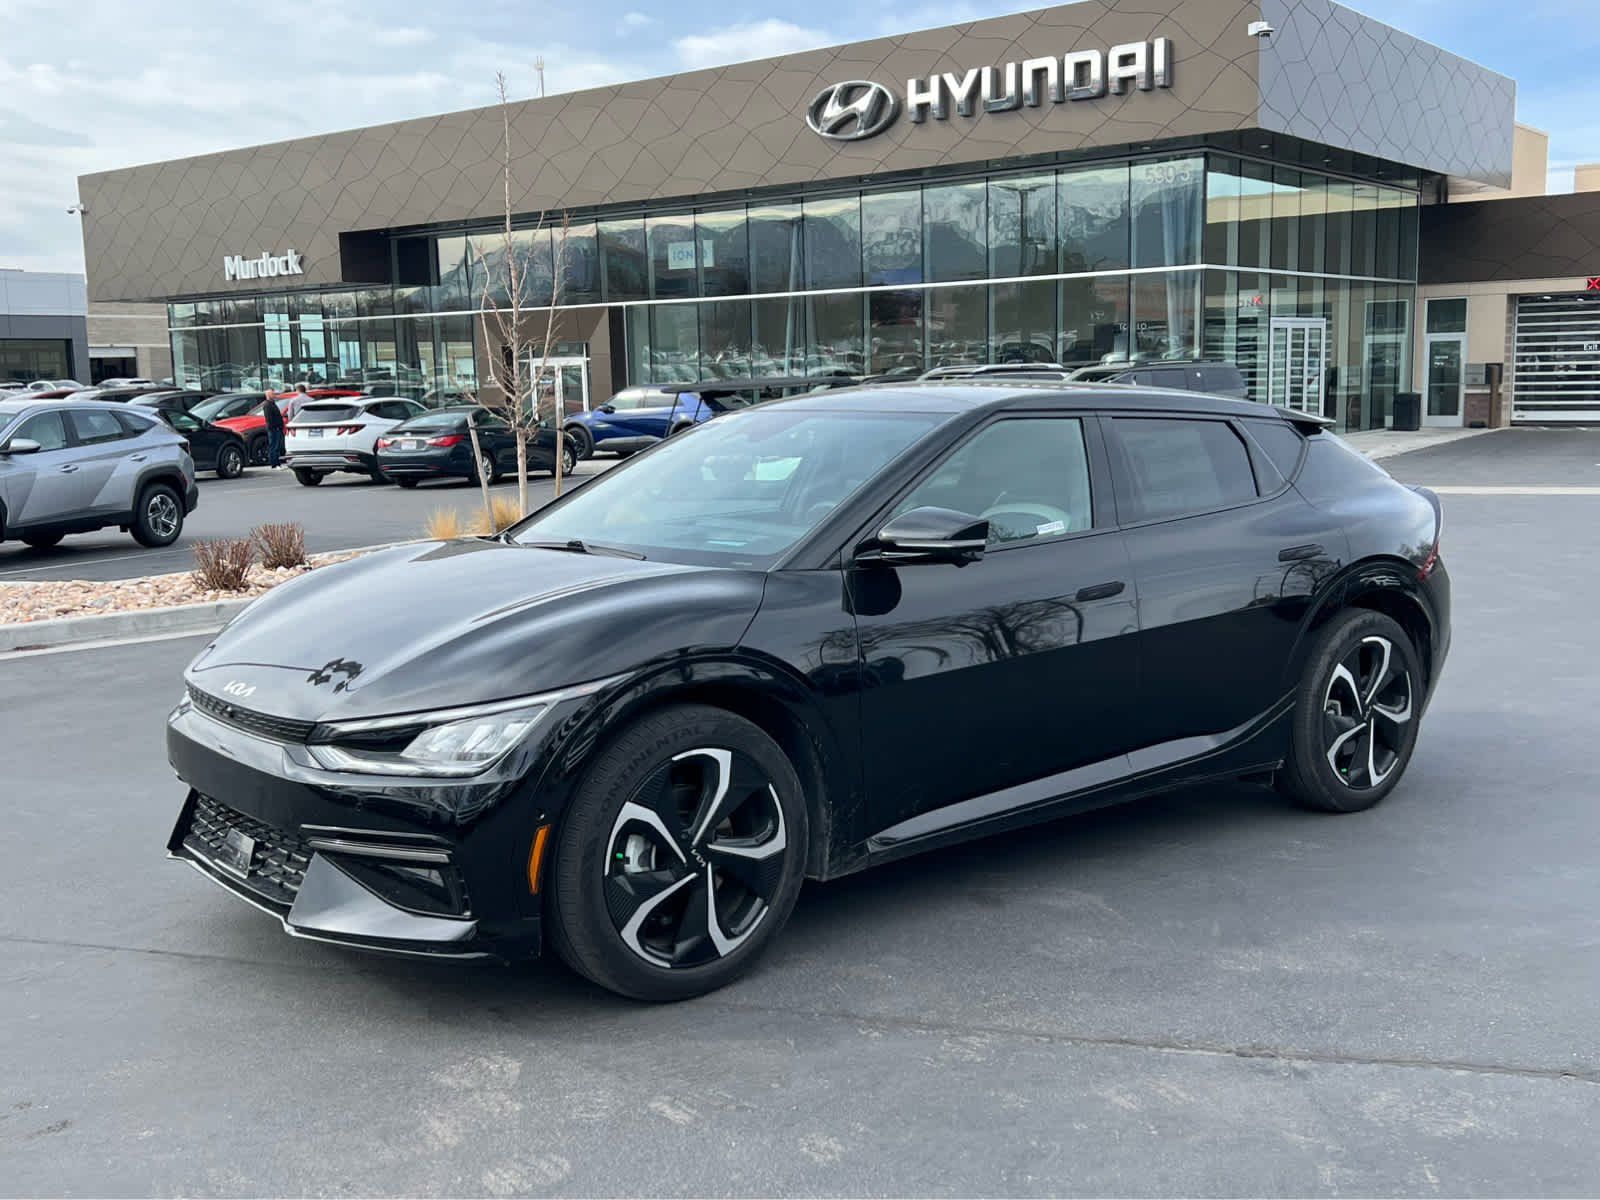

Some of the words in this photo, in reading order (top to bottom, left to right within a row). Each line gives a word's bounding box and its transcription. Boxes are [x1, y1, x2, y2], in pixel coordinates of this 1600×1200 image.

[906, 37, 1172, 124] HYUNDAI
[223, 248, 304, 281] Murdock
[672, 247, 709, 262] ION
[1583, 343, 1598, 351] Exit
